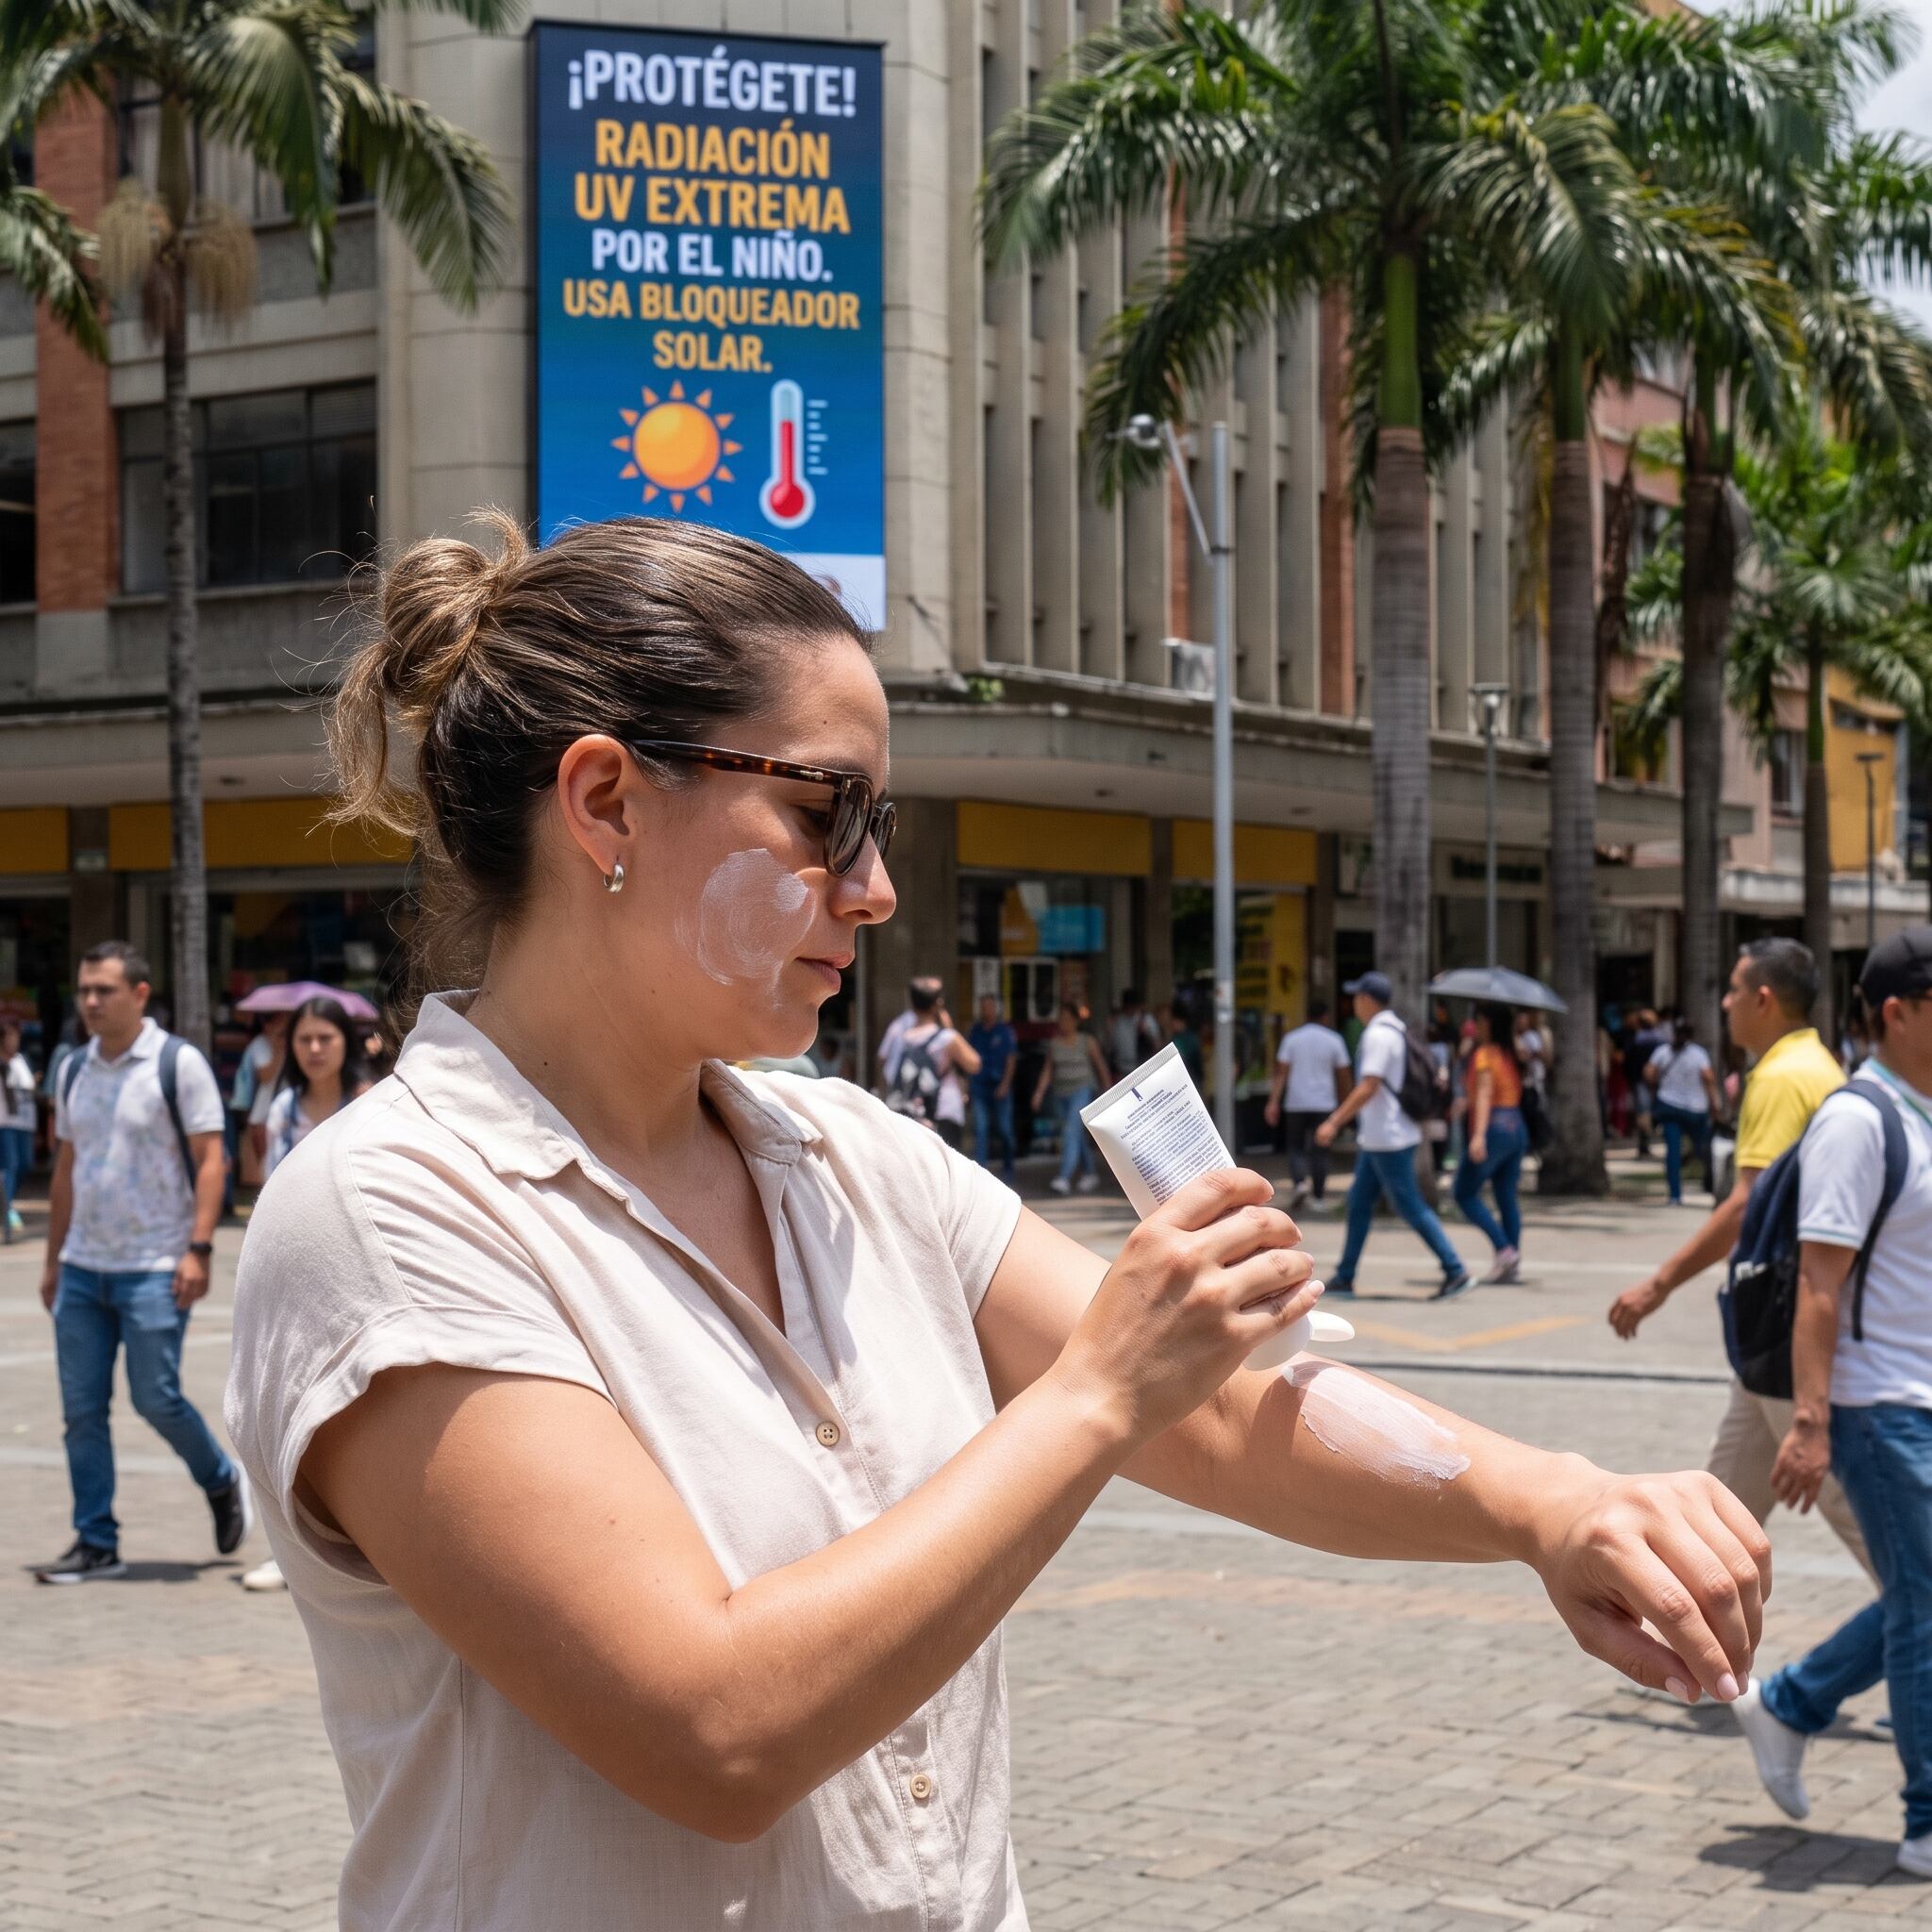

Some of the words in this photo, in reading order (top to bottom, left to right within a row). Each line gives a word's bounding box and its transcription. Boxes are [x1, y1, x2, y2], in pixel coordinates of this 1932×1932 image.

[568, 44, 856, 117] ¡PROTÉGETE!
[595, 119, 830, 179] RADIACIÓN
[575, 172, 635, 222] UV
[646, 176, 851, 234] EXTREMA
[592, 228, 668, 275] POR
[678, 234, 724, 277] EL
[733, 231, 832, 282] NIÑO.
[563, 279, 632, 318] USA
[640, 283, 859, 330] BLOQUEADOR
[653, 330, 772, 373] SOLAR.
